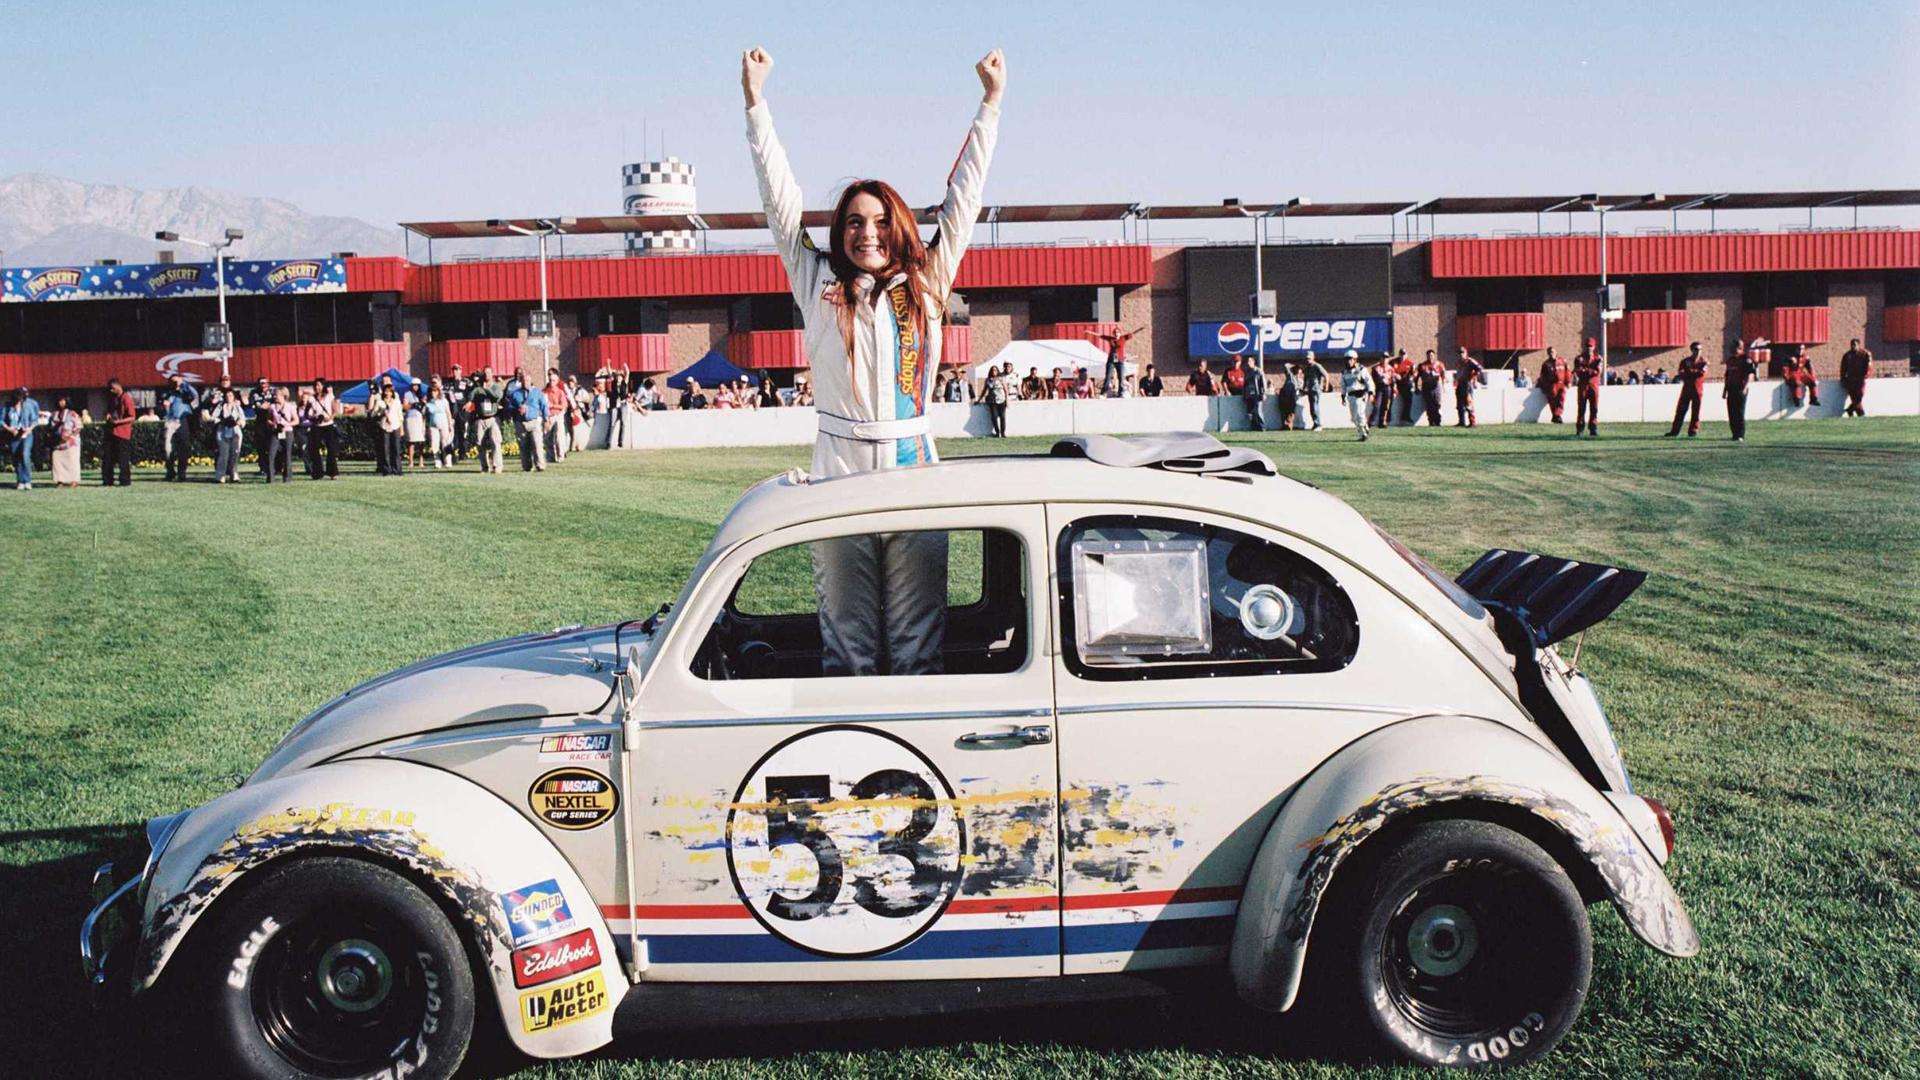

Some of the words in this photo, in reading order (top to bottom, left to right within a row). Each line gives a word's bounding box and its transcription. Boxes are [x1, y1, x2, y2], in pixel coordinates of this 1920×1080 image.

[1254, 320, 1366, 350] PEPSI
[896, 349, 918, 395] Shops
[562, 736, 607, 751] NASCAR
[569, 753, 592, 761] RACE
[594, 752, 612, 760] CAR
[562, 780, 600, 792] NASCAR
[545, 795, 601, 809] NEXTEL
[550, 811, 568, 819] CUP
[569, 811, 599, 819] SERIES
[765, 769, 945, 921] 53
[514, 895, 563, 921] SUNOCO
[227, 916, 281, 990] EAGLE
[523, 939, 595, 977] Edelbrock
[551, 980, 595, 1006] Auto
[548, 991, 605, 1026] Meter
